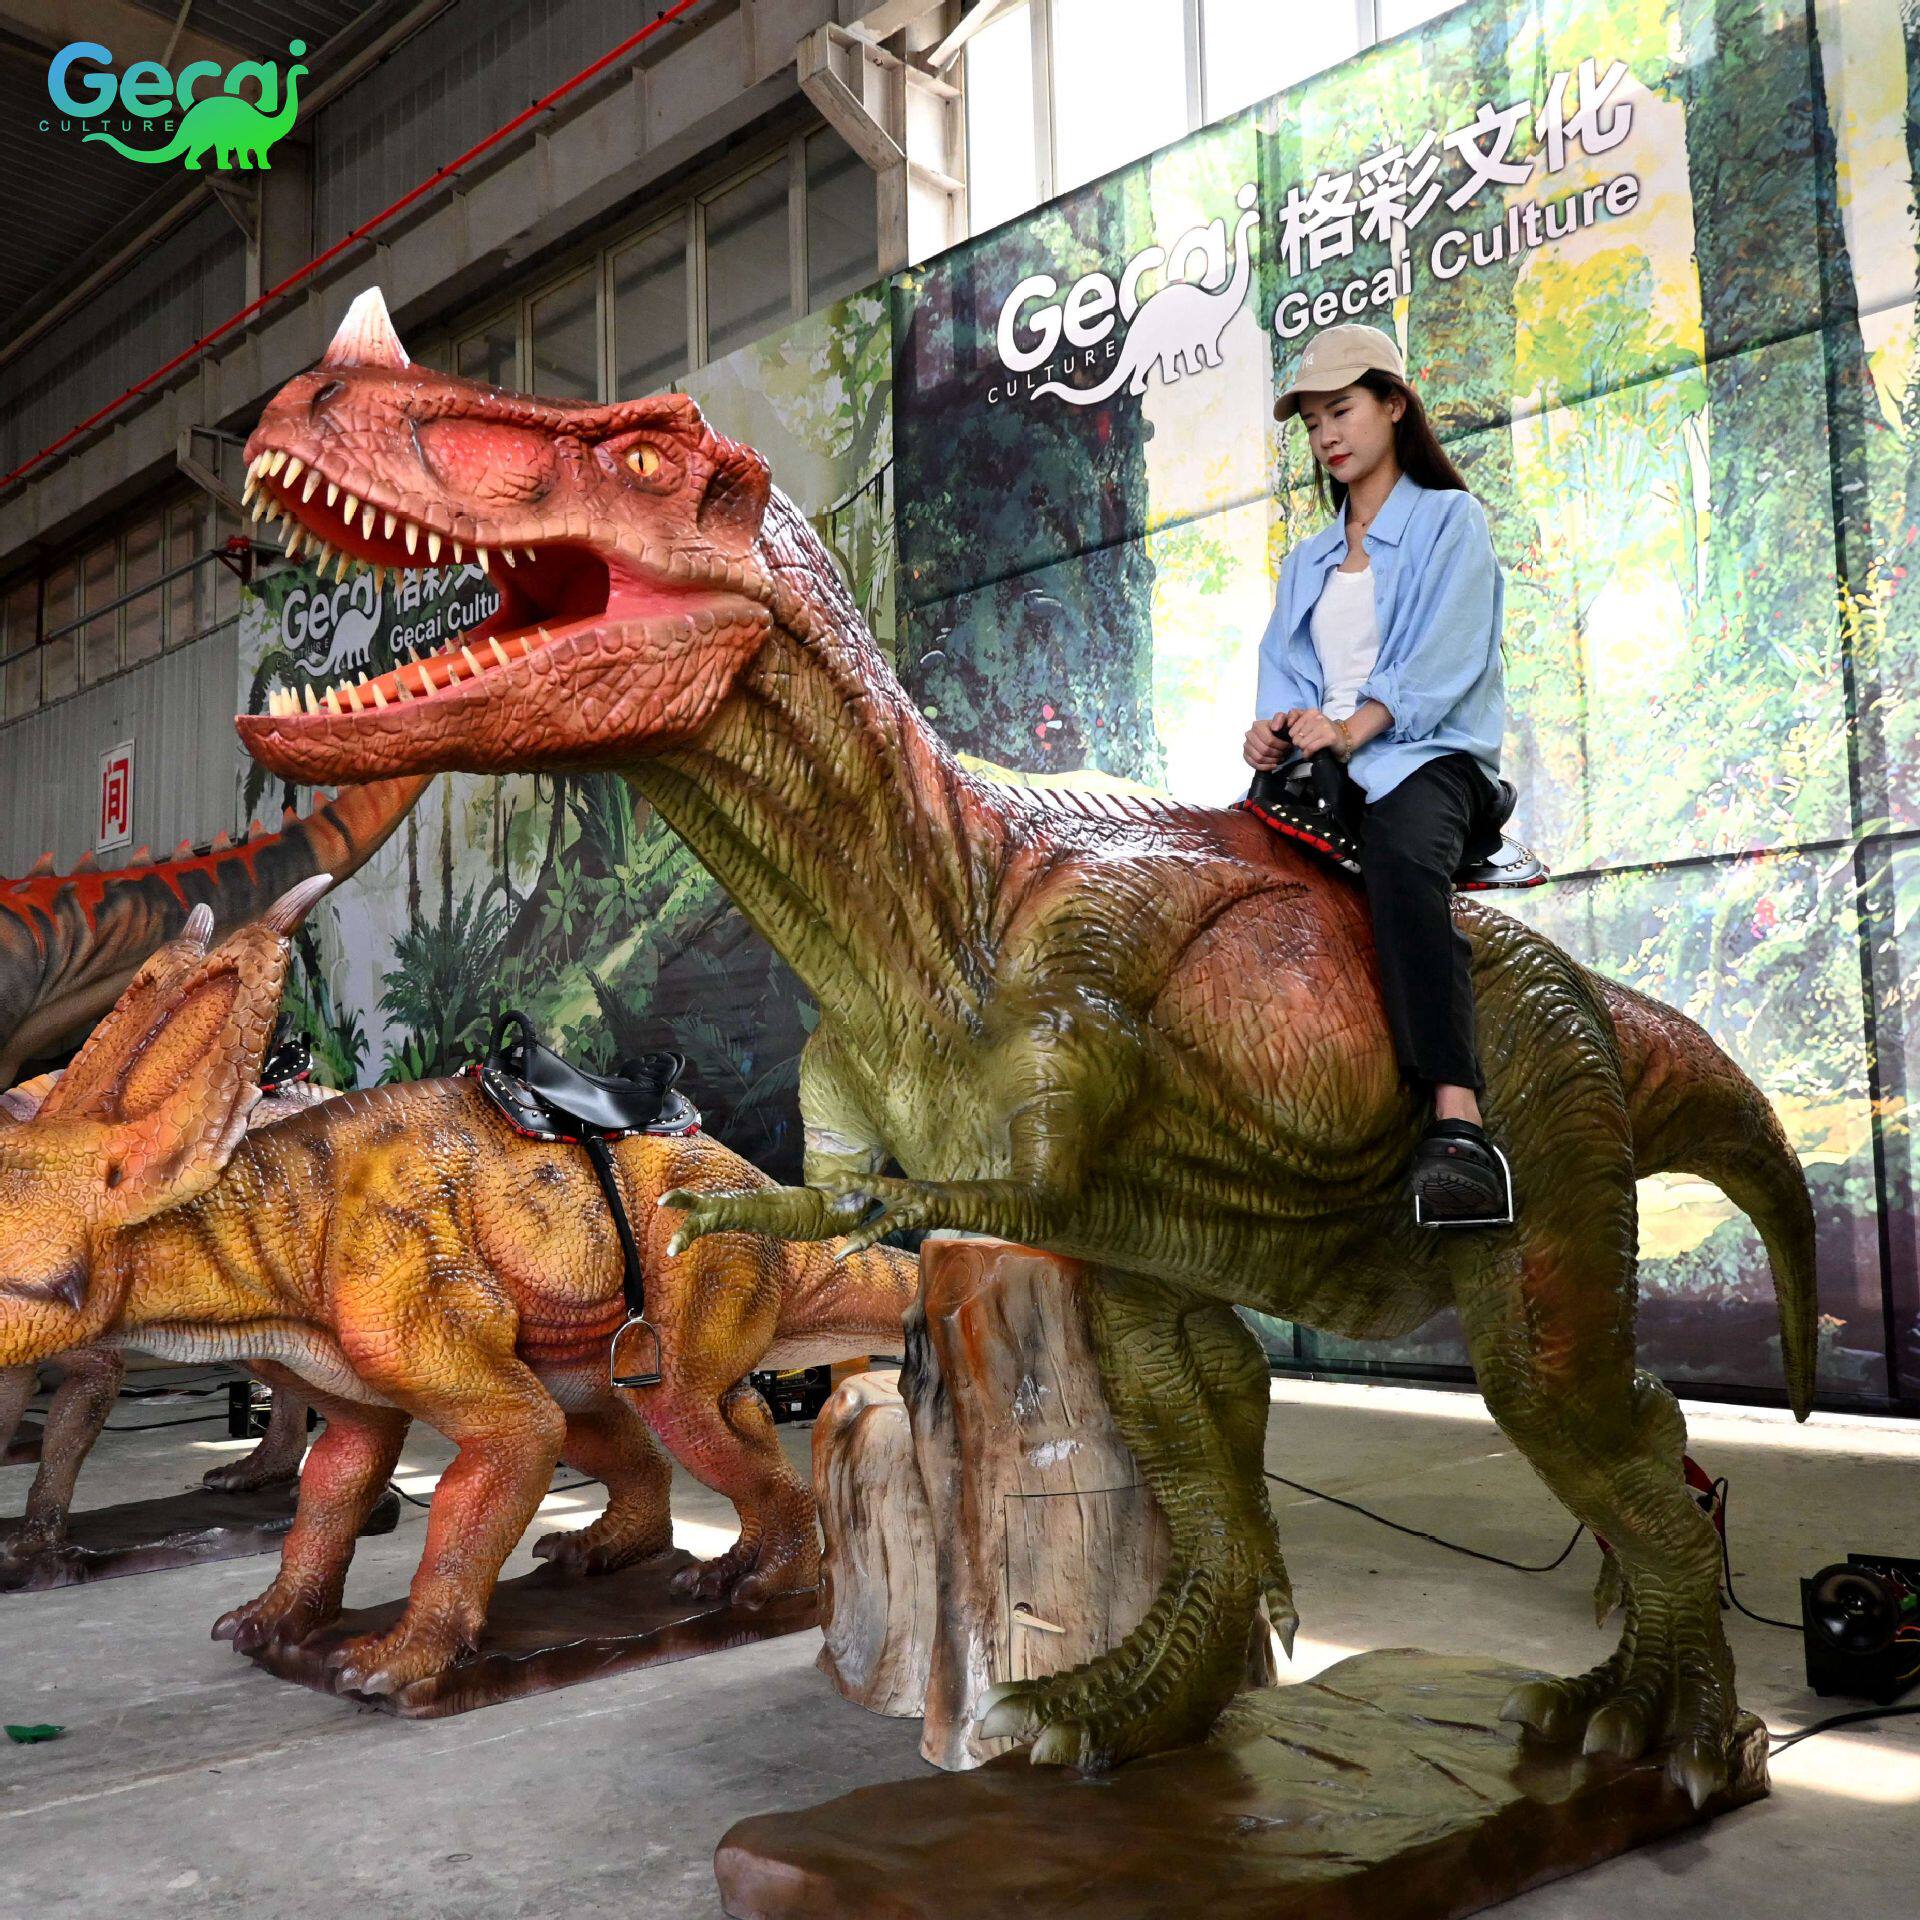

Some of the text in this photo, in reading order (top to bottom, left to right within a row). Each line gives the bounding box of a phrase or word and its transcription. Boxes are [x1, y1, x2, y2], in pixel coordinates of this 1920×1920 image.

[1279, 57, 1632, 277] 格彩文化
[997, 183, 1260, 372] Gecai
[1274, 174, 1639, 338] Gecai Culture
[988, 340, 1115, 404] CULTURE
[390, 592, 500, 653] Gecai Cultu
[101, 757, 129, 839] 间
